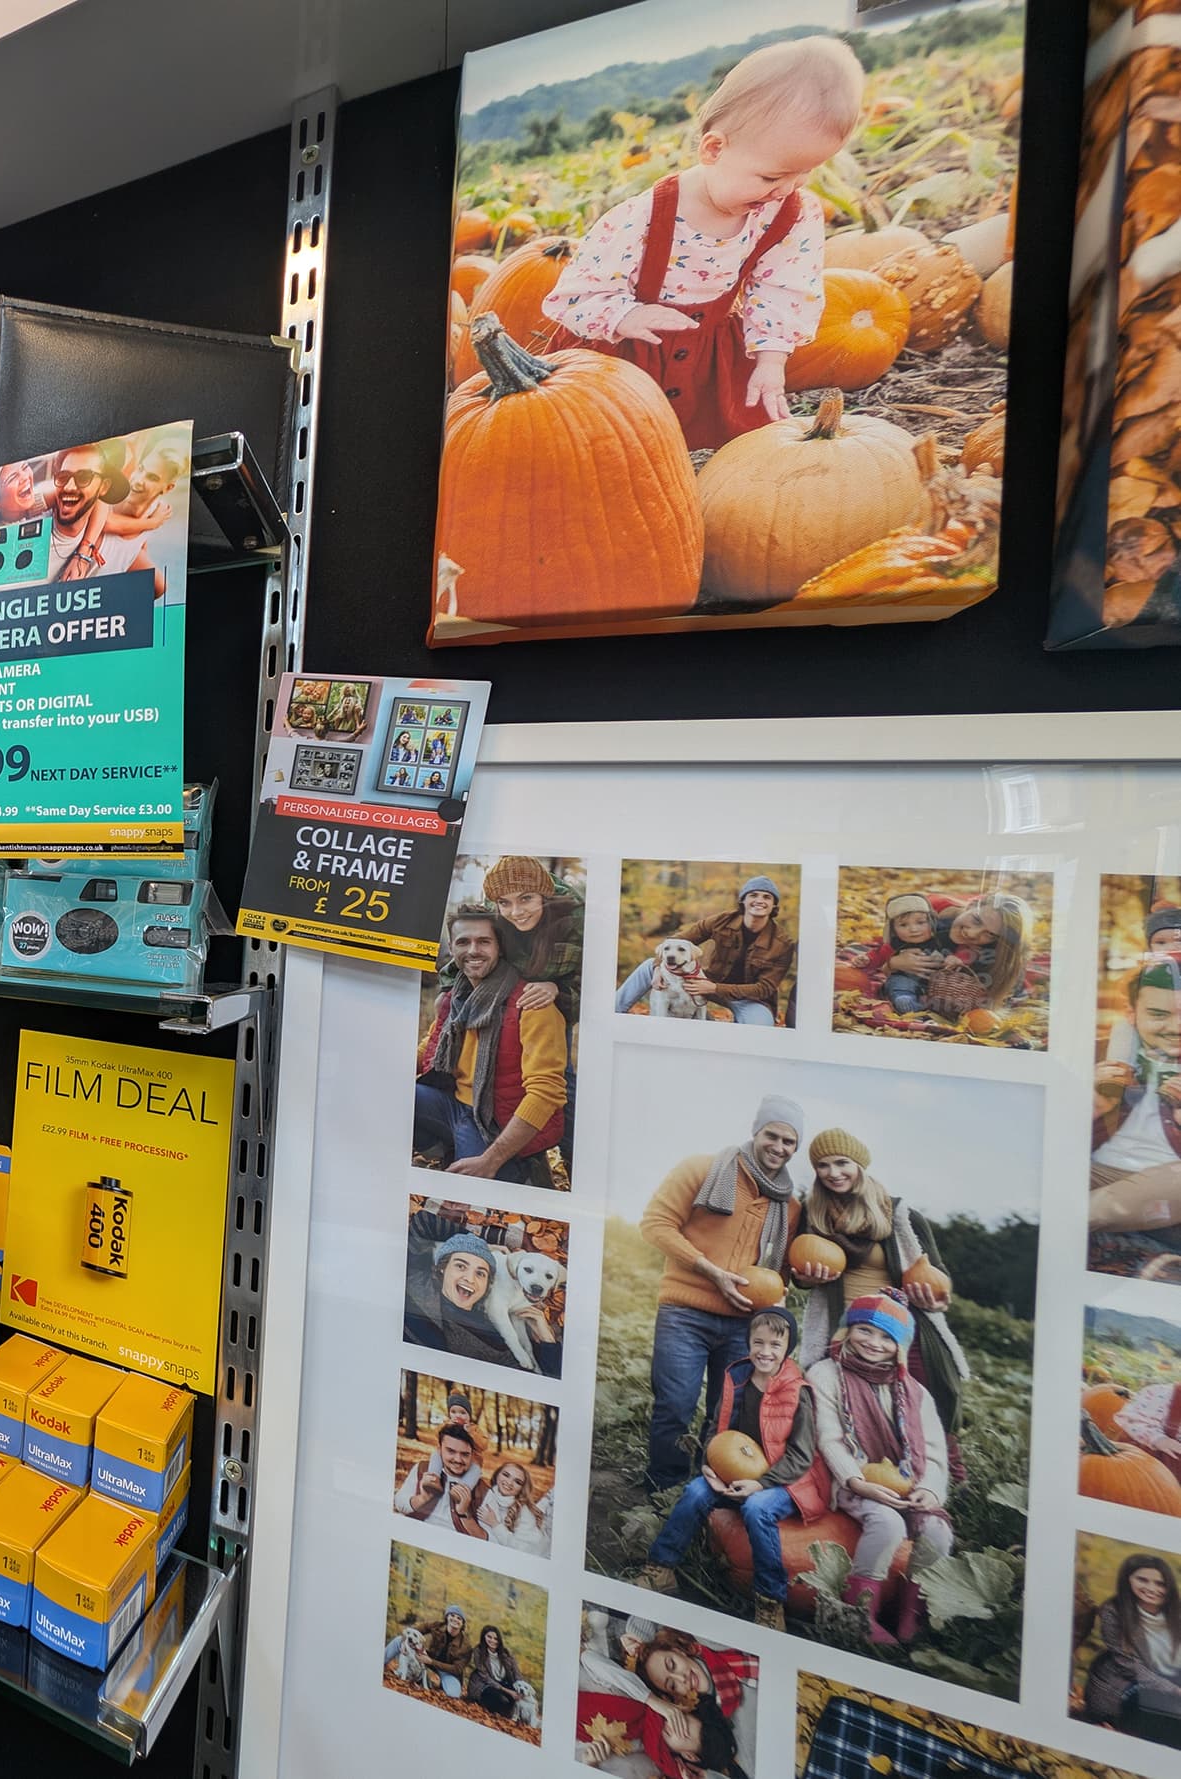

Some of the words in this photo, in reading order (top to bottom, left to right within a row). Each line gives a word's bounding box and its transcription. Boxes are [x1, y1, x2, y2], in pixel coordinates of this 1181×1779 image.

[56, 587, 102, 612] USE
[47, 615, 126, 644] OFFER
[16, 698, 35, 710] OR
[38, 694, 93, 710] DIGITAL
[2, 714, 54, 730] transfer
[57, 713, 84, 726] into
[88, 712, 120, 728] your
[124, 707, 159, 723] USB)
[30, 768, 66, 781] NEXT
[70, 767, 98, 780] DAY
[69, 804, 91, 818] Day
[94, 803, 136, 816] Service
[138, 803, 172, 815] £3.00
[283, 801, 369, 821] PERSONALISED
[372, 812, 439, 830] COLLAGES
[110, 827, 173, 838] snappysnaps
[296, 826, 414, 860] COLLAGE
[293, 851, 310, 871] &
[316, 854, 407, 885] FRAME
[289, 876, 330, 894] FROM
[156, 913, 182, 922] FLASH
[314, 896, 327, 914] £
[340, 886, 391, 922] 25
[12, 922, 49, 937] WOW!
[65, 1056, 89, 1066] 35mm
[91, 1059, 116, 1071] Kodak
[118, 1065, 155, 1078] UltraMax
[157, 1071, 172, 1080] 400
[25, 1062, 102, 1103] FILM
[117, 1077, 219, 1125] DEAL
[42, 1124, 67, 1136] £22.99
[69, 1130, 89, 1141] FILM
[100, 1136, 121, 1148] FREE
[88, 1203, 105, 1249] 400
[109, 1196, 128, 1266] Kodak
[9, 1311, 41, 1327] Available
[41, 1322, 56, 1333] only
[58, 1328, 65, 1336] at
[66, 1330, 80, 1341] this
[81, 1334, 109, 1351] branch.
[53, 1300, 94, 1318] DEVELOPMENT
[105, 1318, 127, 1330] DIGITAL
[128, 1325, 145, 1336] SCAN
[119, 1346, 199, 1381] snappysnaps
[28, 1443, 72, 1470] UltraMax
[98, 1467, 146, 1497] UltraMax
